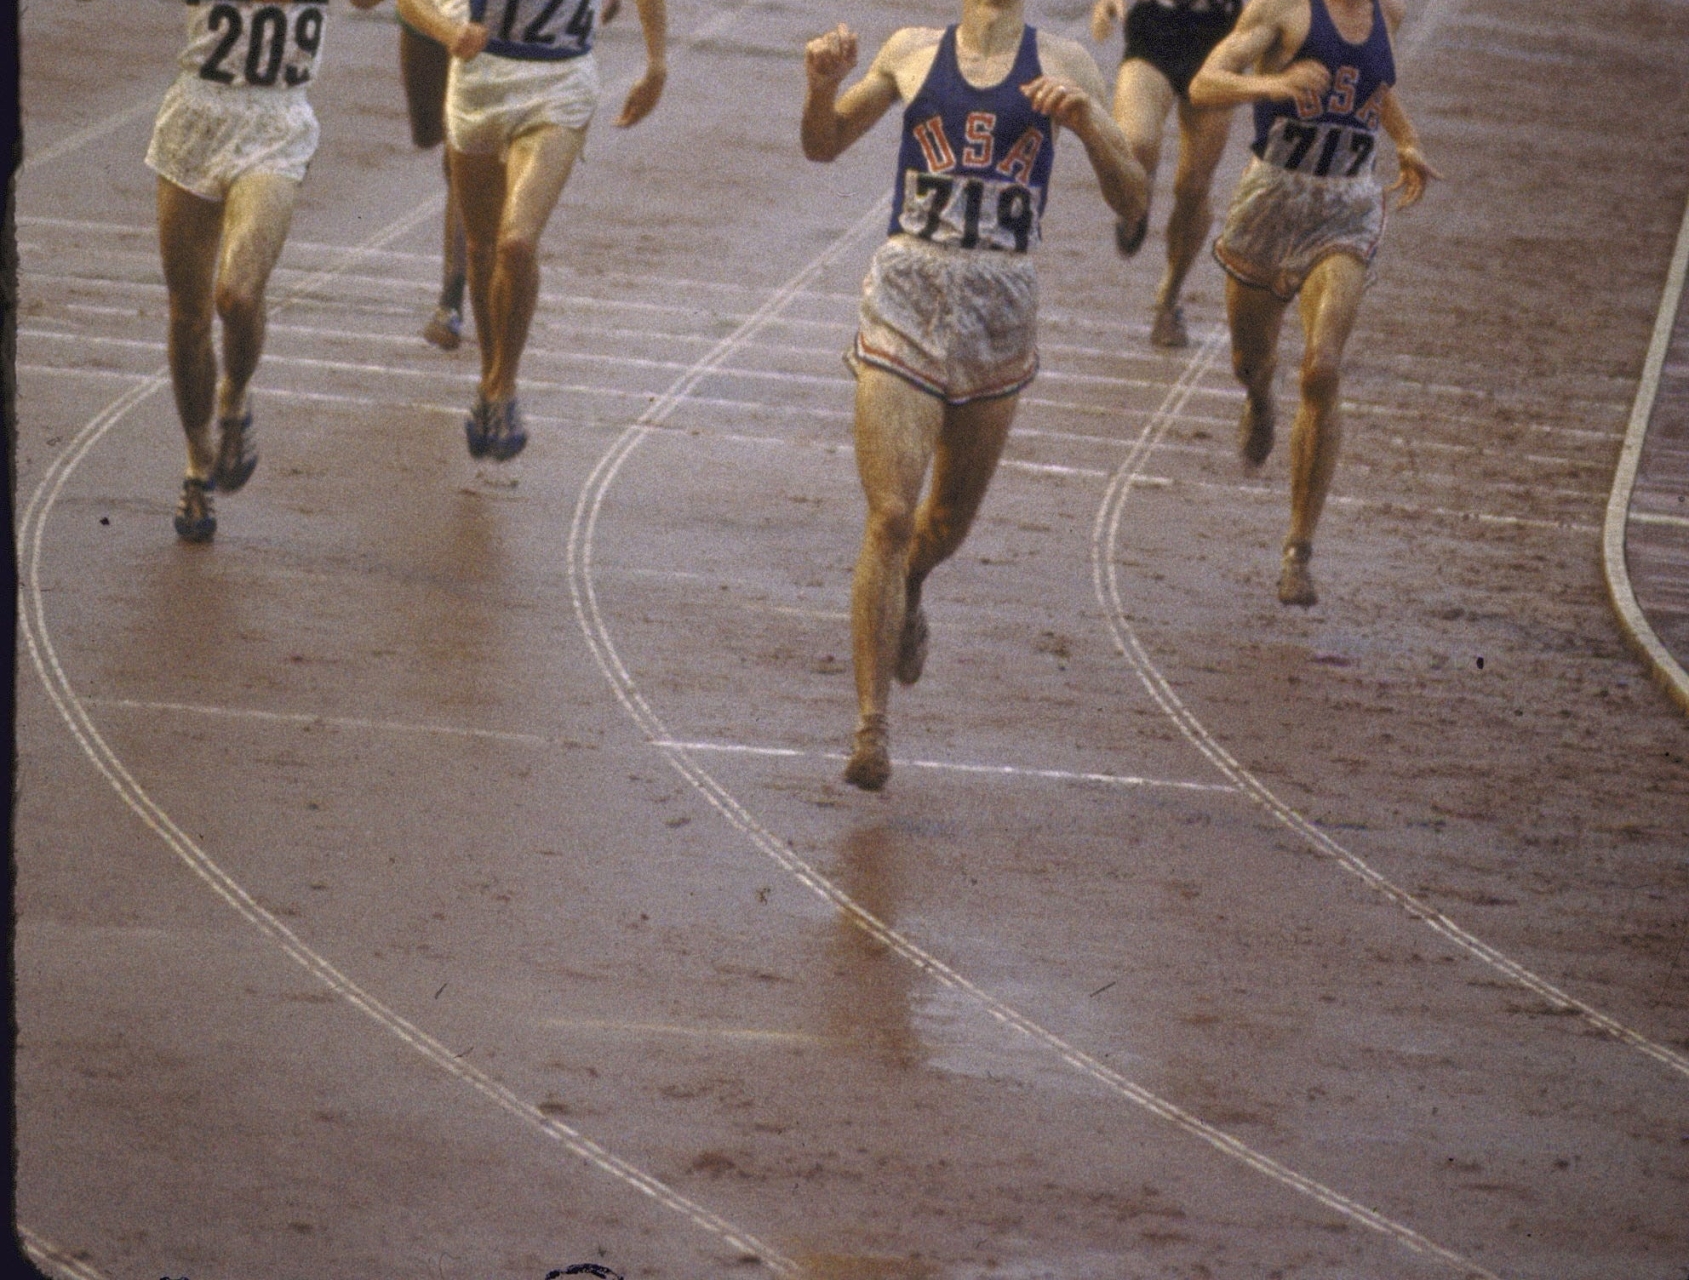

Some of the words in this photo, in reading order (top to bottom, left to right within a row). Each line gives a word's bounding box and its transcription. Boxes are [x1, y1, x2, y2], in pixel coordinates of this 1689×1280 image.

[200, 4, 323, 87] 209
[913, 112, 1044, 186] USA
[1283, 121, 1375, 178] 717
[915, 172, 1033, 253] 719
